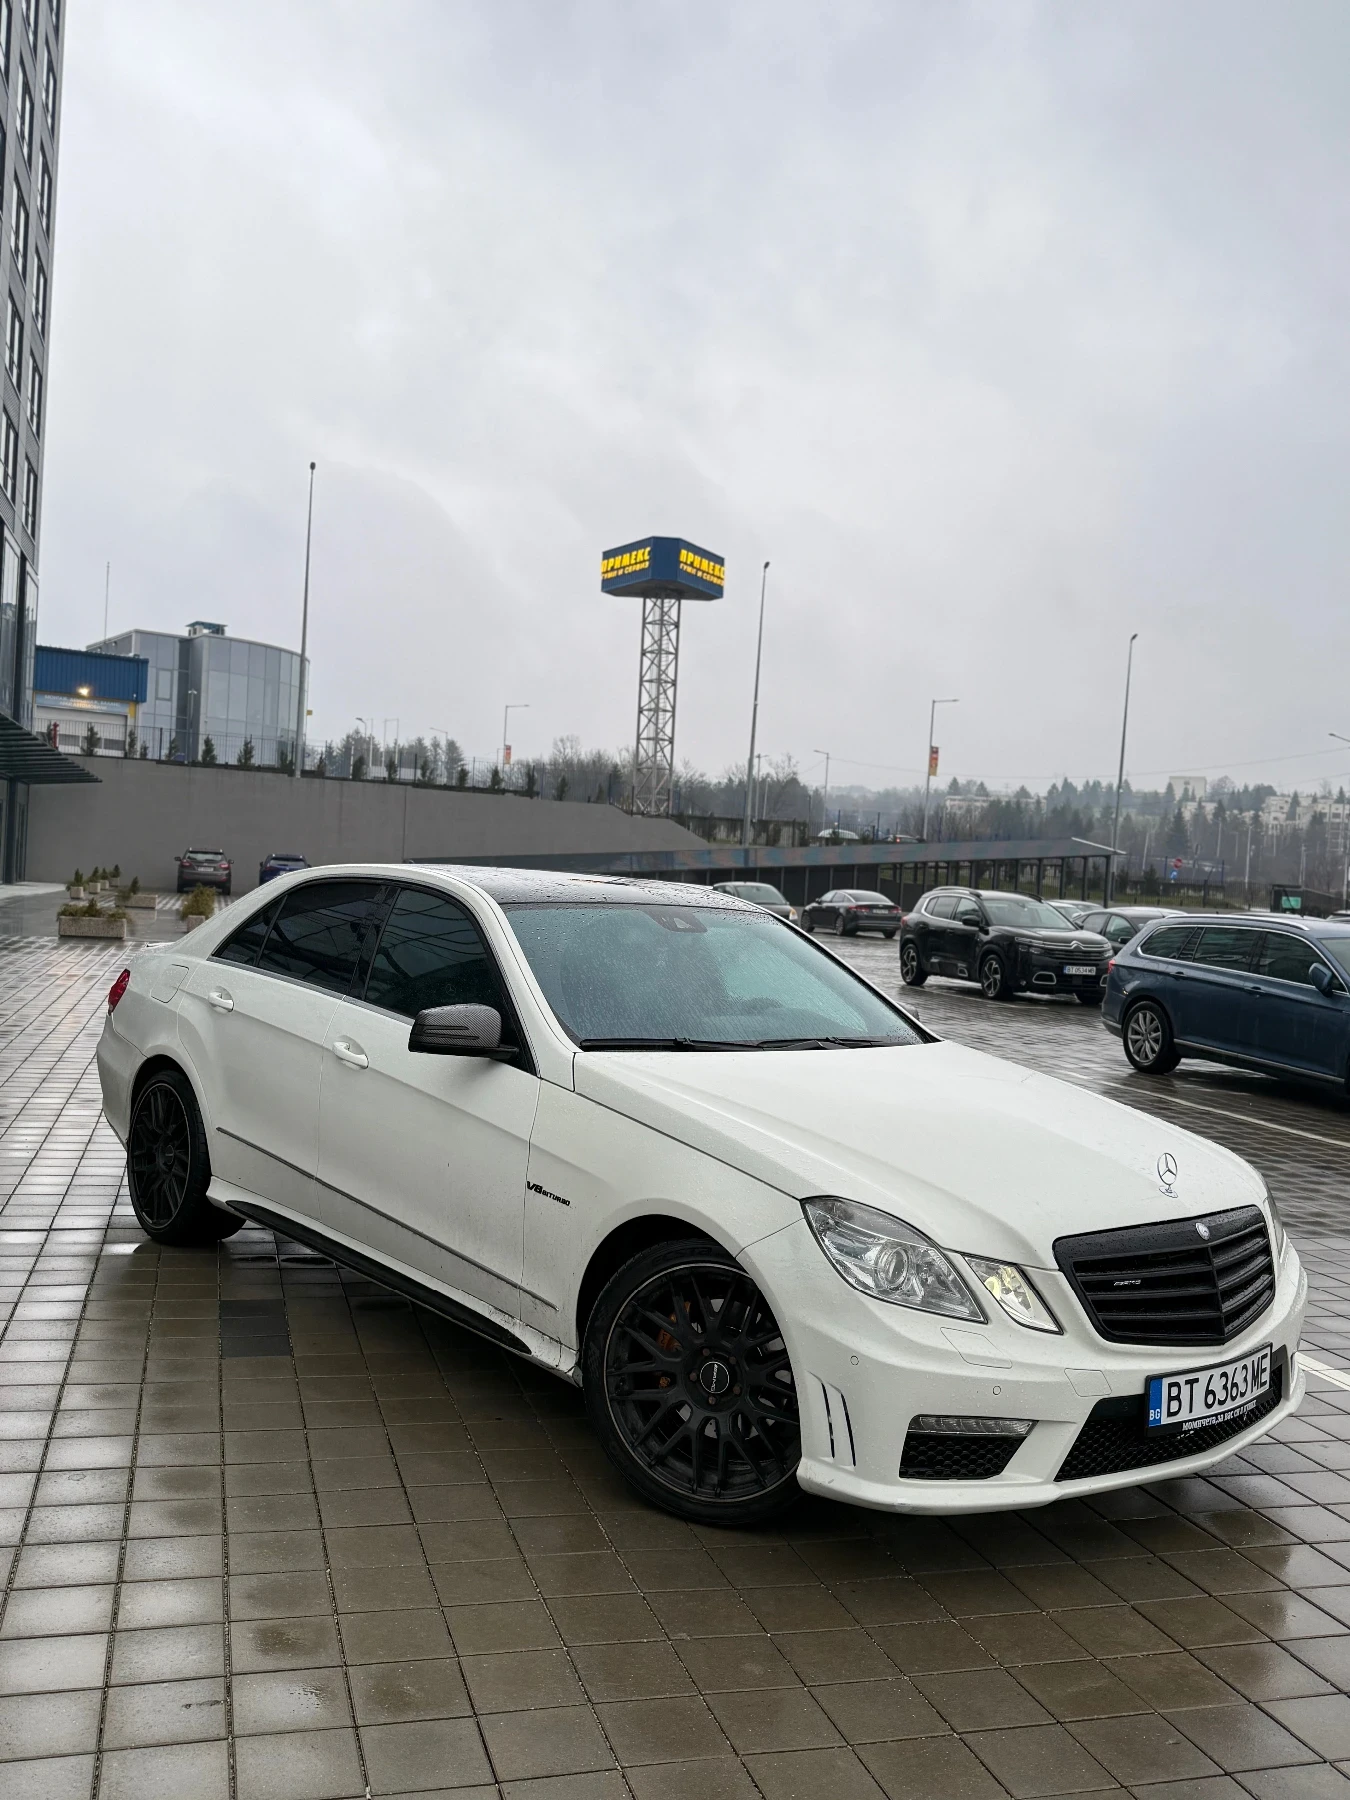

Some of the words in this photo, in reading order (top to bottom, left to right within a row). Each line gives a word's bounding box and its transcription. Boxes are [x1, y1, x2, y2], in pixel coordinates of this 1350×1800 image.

[601, 547, 651, 573] ПРИМЕКС
[679, 549, 725, 579] ПРИМЕКС
[1167, 1377, 1200, 1418] BT
[1204, 1366, 1249, 1409] 6363
[1250, 1352, 1269, 1395] ME
[1149, 1408, 1161, 1421] BG
